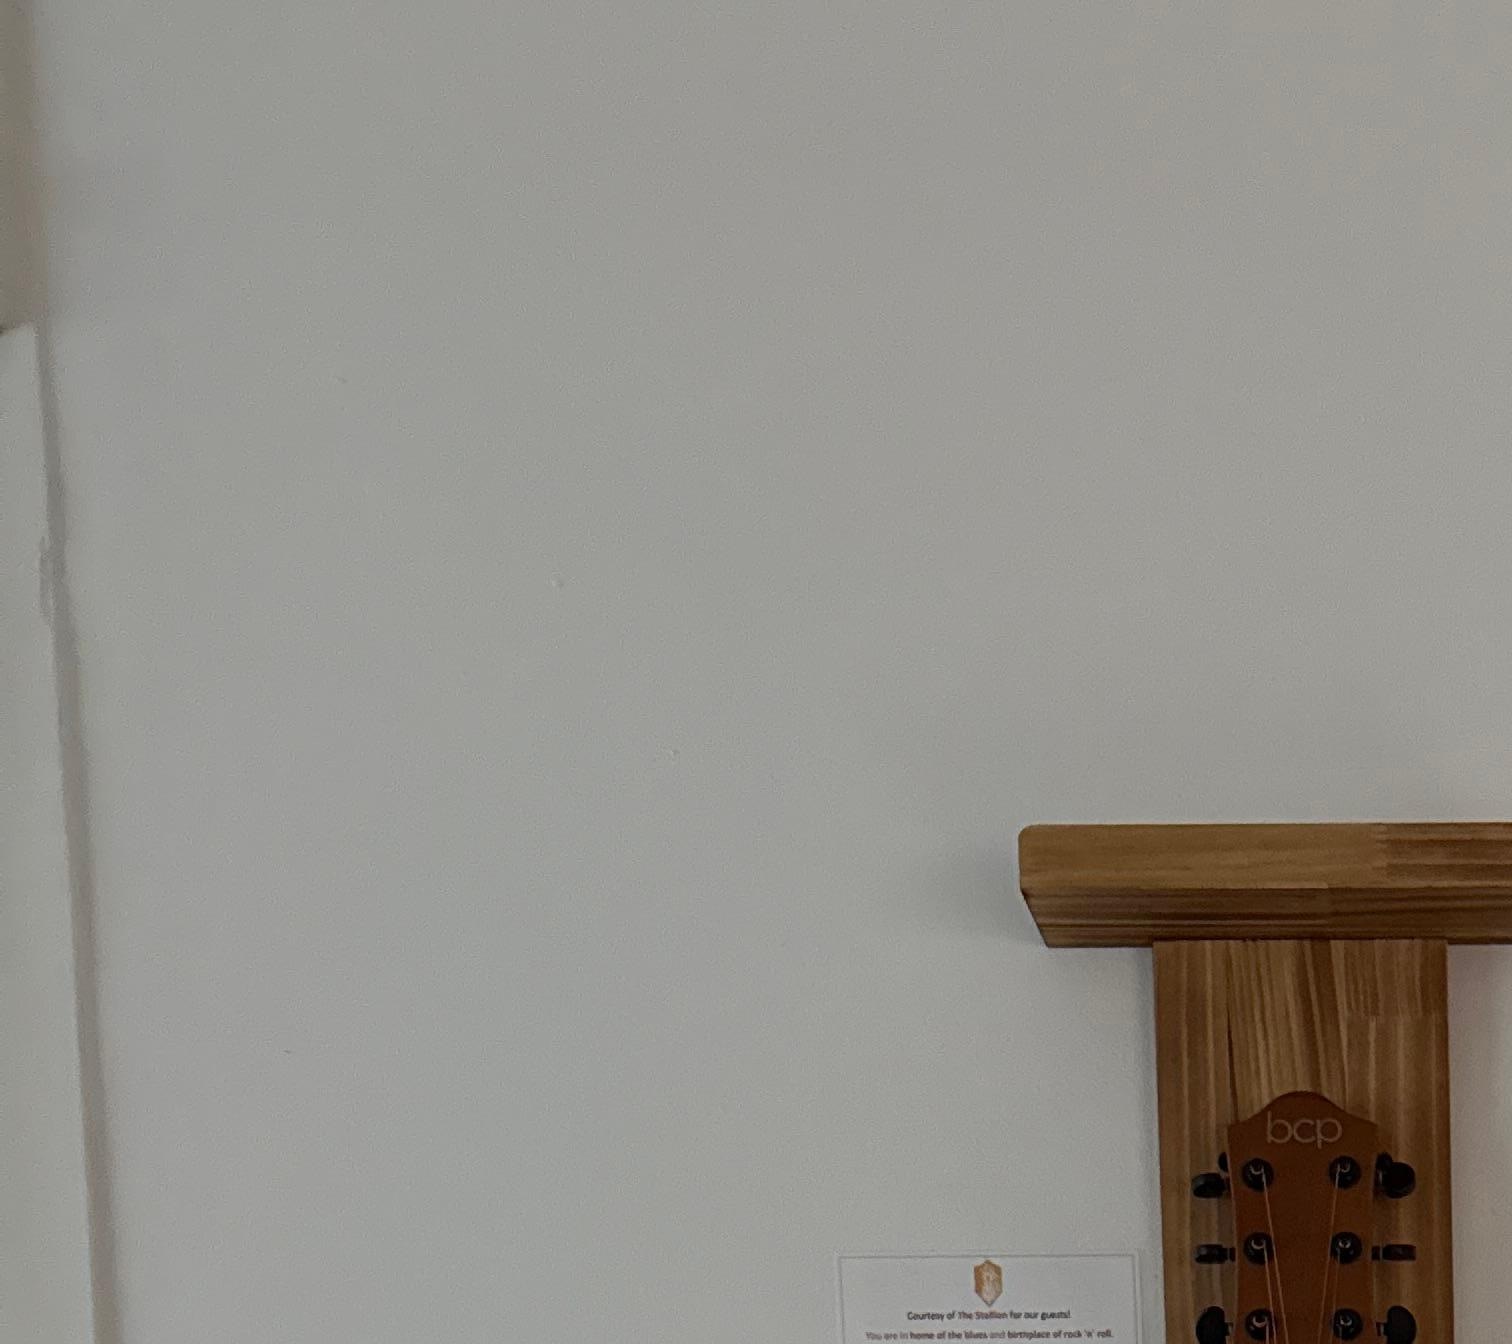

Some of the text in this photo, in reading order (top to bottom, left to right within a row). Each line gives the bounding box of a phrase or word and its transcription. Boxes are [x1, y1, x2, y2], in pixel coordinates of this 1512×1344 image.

[1266, 1110, 1343, 1150] bcp
[907, 1311, 944, 1322] Courtesy
[946, 1310, 956, 1320] of
[958, 1310, 973, 1320] The
[1009, 1309, 1022, 1319] for
[865, 1331, 882, 1340] You
[899, 1331, 908, 1339] in
[909, 1331, 934, 1339] home
[936, 1331, 946, 1339] of
[948, 1330, 962, 1339] the
[964, 1330, 988, 1339] blues
[990, 1330, 1005, 1339] and
[1007, 1330, 1051, 1340] birthplace
[1053, 1330, 1062, 1338] of
[1063, 1330, 1081, 1338] rock
